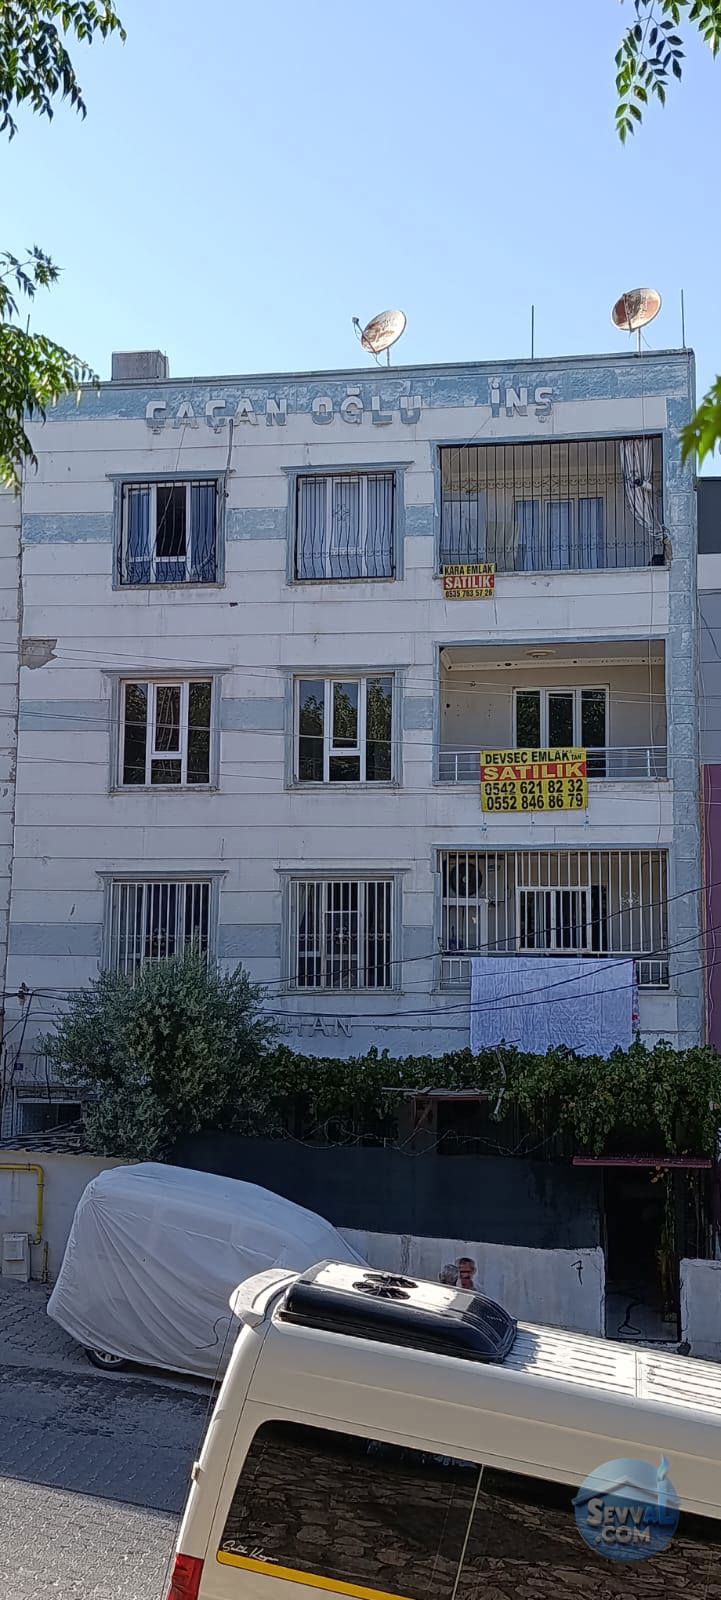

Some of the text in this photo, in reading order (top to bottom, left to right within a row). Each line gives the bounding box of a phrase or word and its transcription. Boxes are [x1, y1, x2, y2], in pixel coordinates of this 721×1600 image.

[444, 564, 492, 576] KARA EMLAK
[445, 576, 491, 589] SATILIK
[531, 750, 570, 763] EMLAK
[484, 762, 583, 780] SATILIK
[485, 778, 583, 796] 0542 621 82 32
[487, 792, 583, 811] 0552 846 86 79
